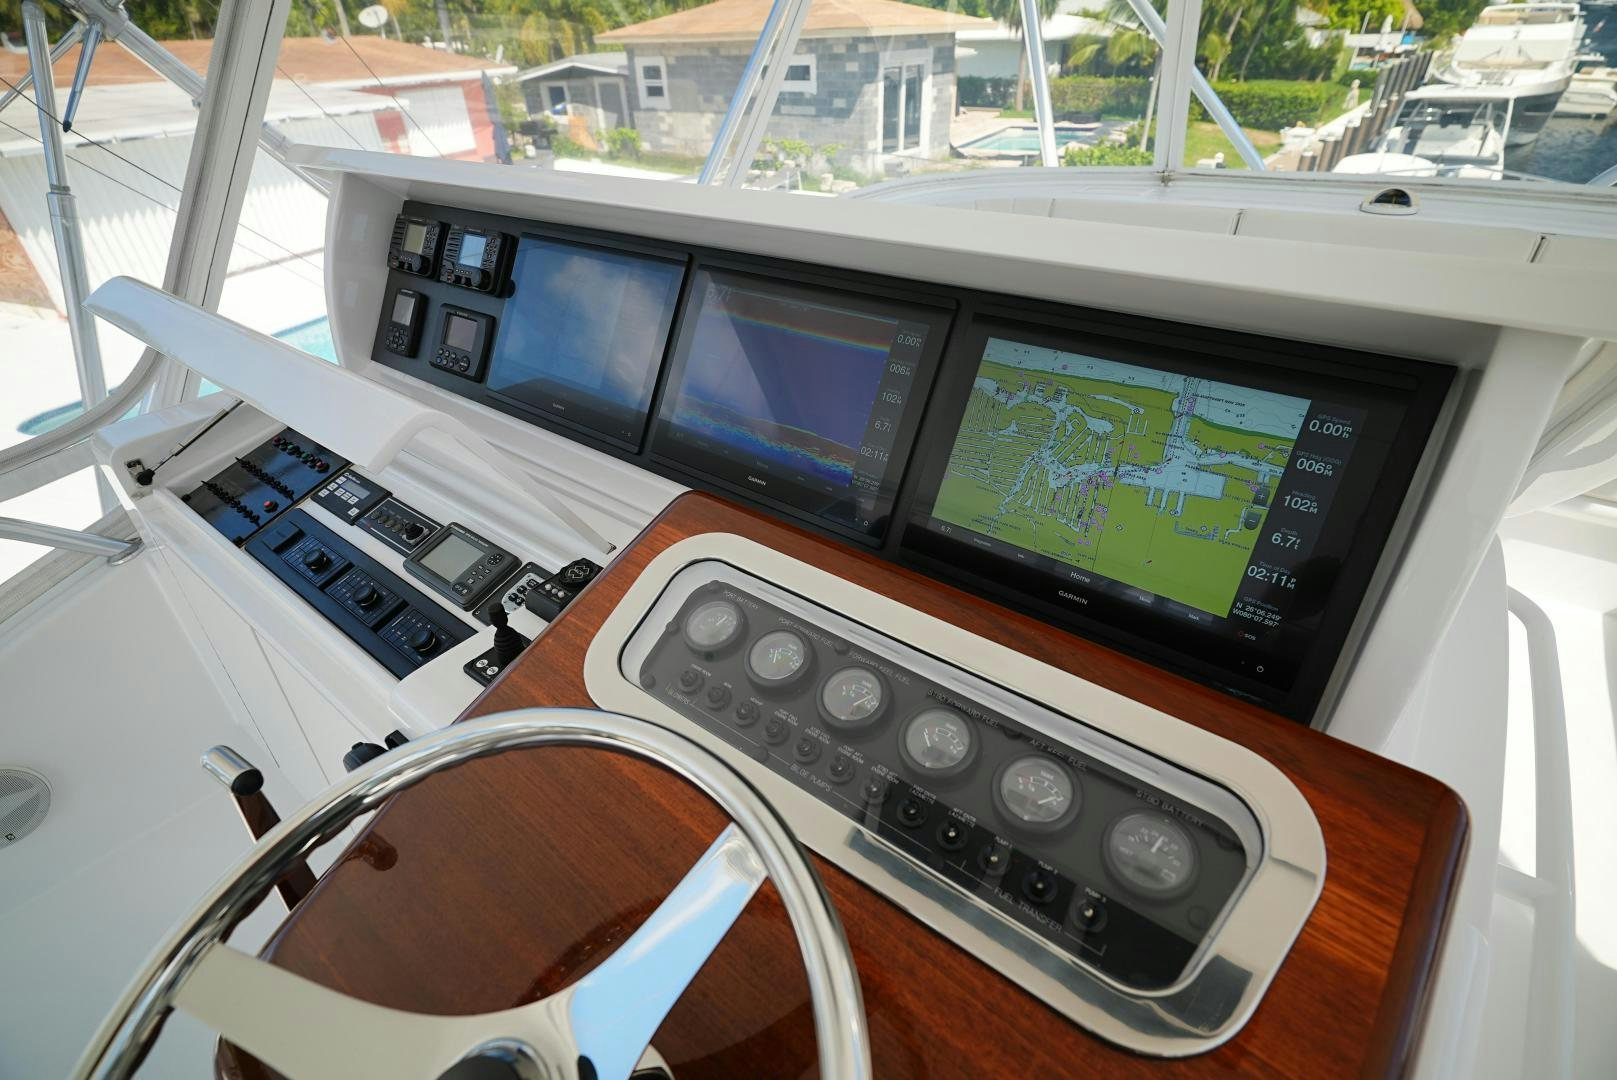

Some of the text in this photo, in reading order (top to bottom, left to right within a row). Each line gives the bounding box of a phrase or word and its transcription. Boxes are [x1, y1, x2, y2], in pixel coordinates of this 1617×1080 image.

[1310, 420, 1342, 436] 0.00
[1272, 533, 1296, 548] 6.7
[1070, 572, 1090, 584] Home
[1248, 566, 1288, 586] 02:11
[1058, 590, 1088, 605] GARMIN
[982, 714, 1000, 728] FUEL
[1084, 887, 1102, 898] PUMP
[994, 886, 1063, 933] FUEL TRANSFER
